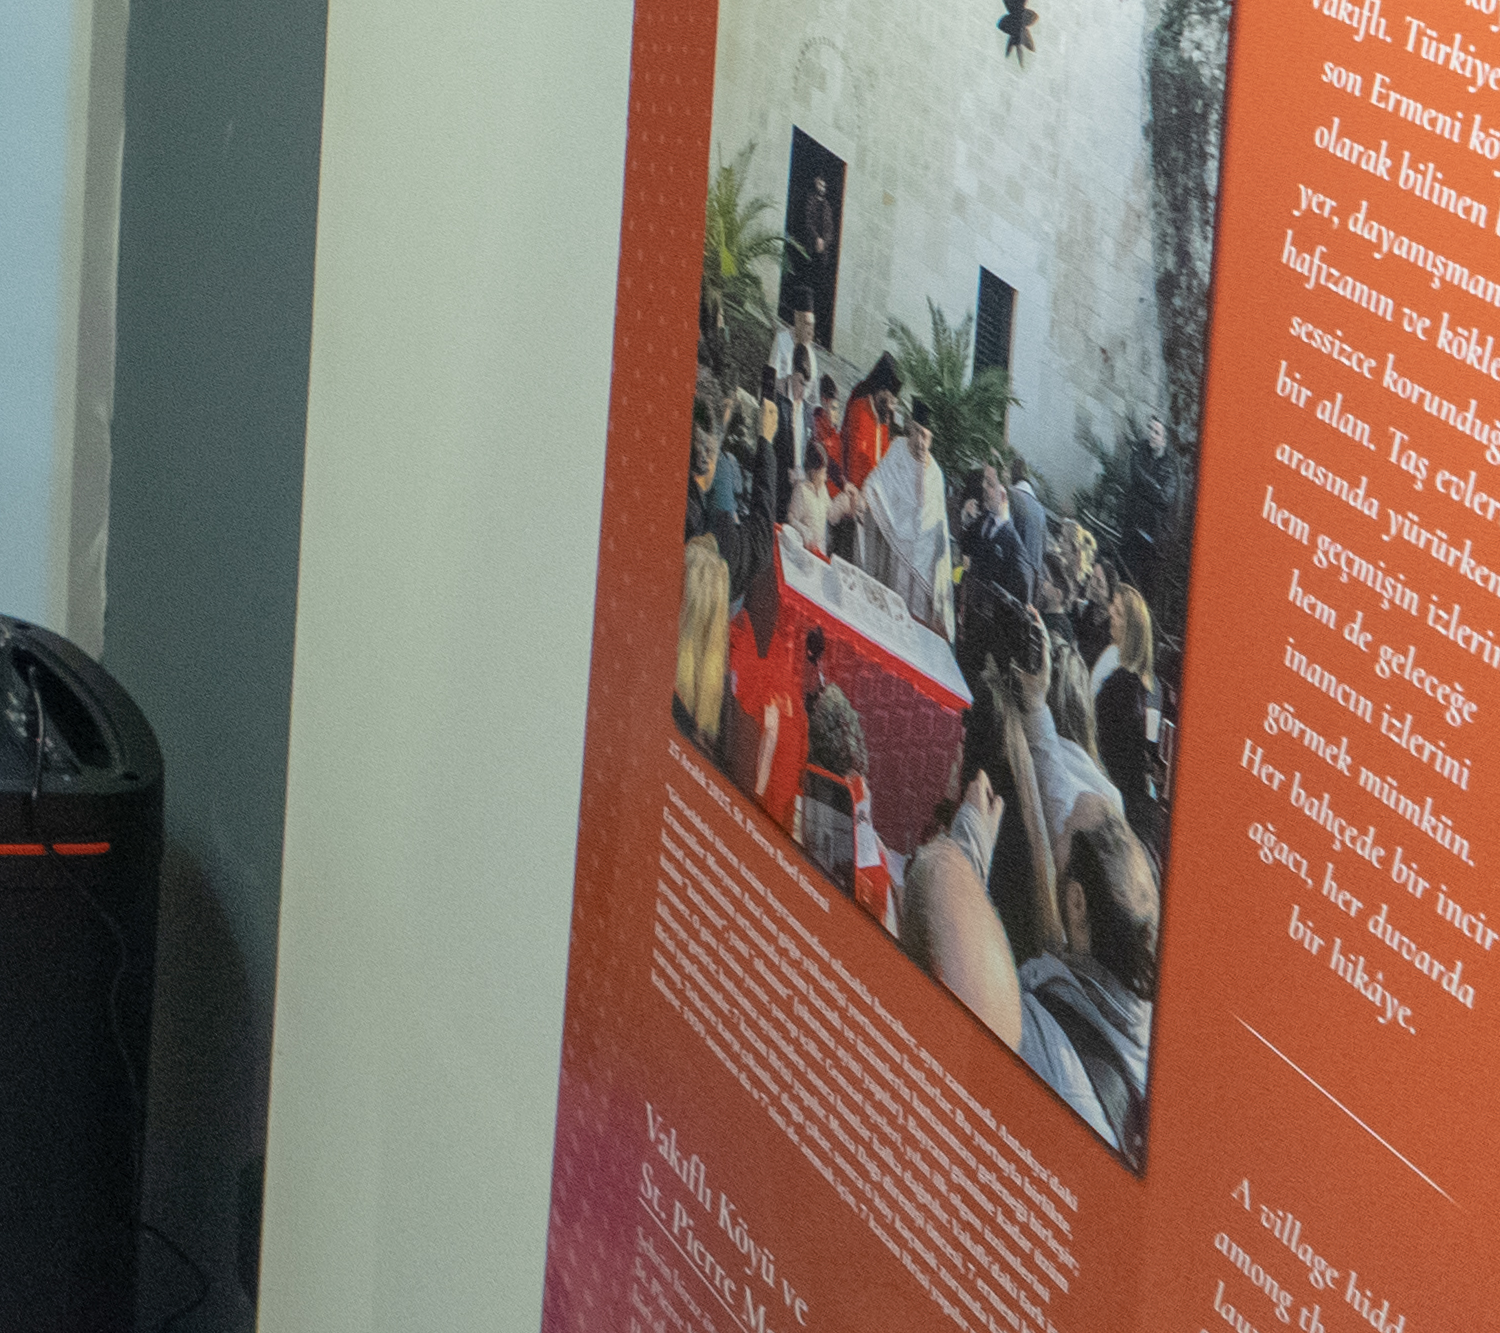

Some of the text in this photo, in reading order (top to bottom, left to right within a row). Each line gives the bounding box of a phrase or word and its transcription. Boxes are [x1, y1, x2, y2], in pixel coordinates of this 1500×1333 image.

[1320, 60, 1463, 143] son Ermeni
[1291, 182, 1339, 229] yer,
[1313, 116, 1487, 228] olarak bilinen
[1280, 228, 1394, 321] hafızanın
[1401, 306, 1431, 341] ve
[1288, 315, 1376, 379] sessizce
[1274, 443, 1379, 519] arasında
[1275, 359, 1312, 408] bir
[1315, 391, 1376, 451] alan.
[1388, 425, 1429, 491] Taş
[1261, 484, 1310, 545] hem
[1312, 534, 1419, 616] geçmişin
[1283, 636, 1471, 790] inancın izlerini
[1287, 567, 1477, 727] hem de geleceğe
[1239, 737, 1499, 950] Her bahçede bir incir
[1262, 701, 1474, 866] görmek mümkün.
[1247, 821, 1475, 1009] ağacı, her duvarda
[1287, 903, 1415, 1034] bir hikâye.
[641, 1162, 667, 1220] St.
[673, 1200, 738, 1305] Pierre
[718, 1192, 776, 1288] Köyü
[782, 1278, 809, 1328] ve
